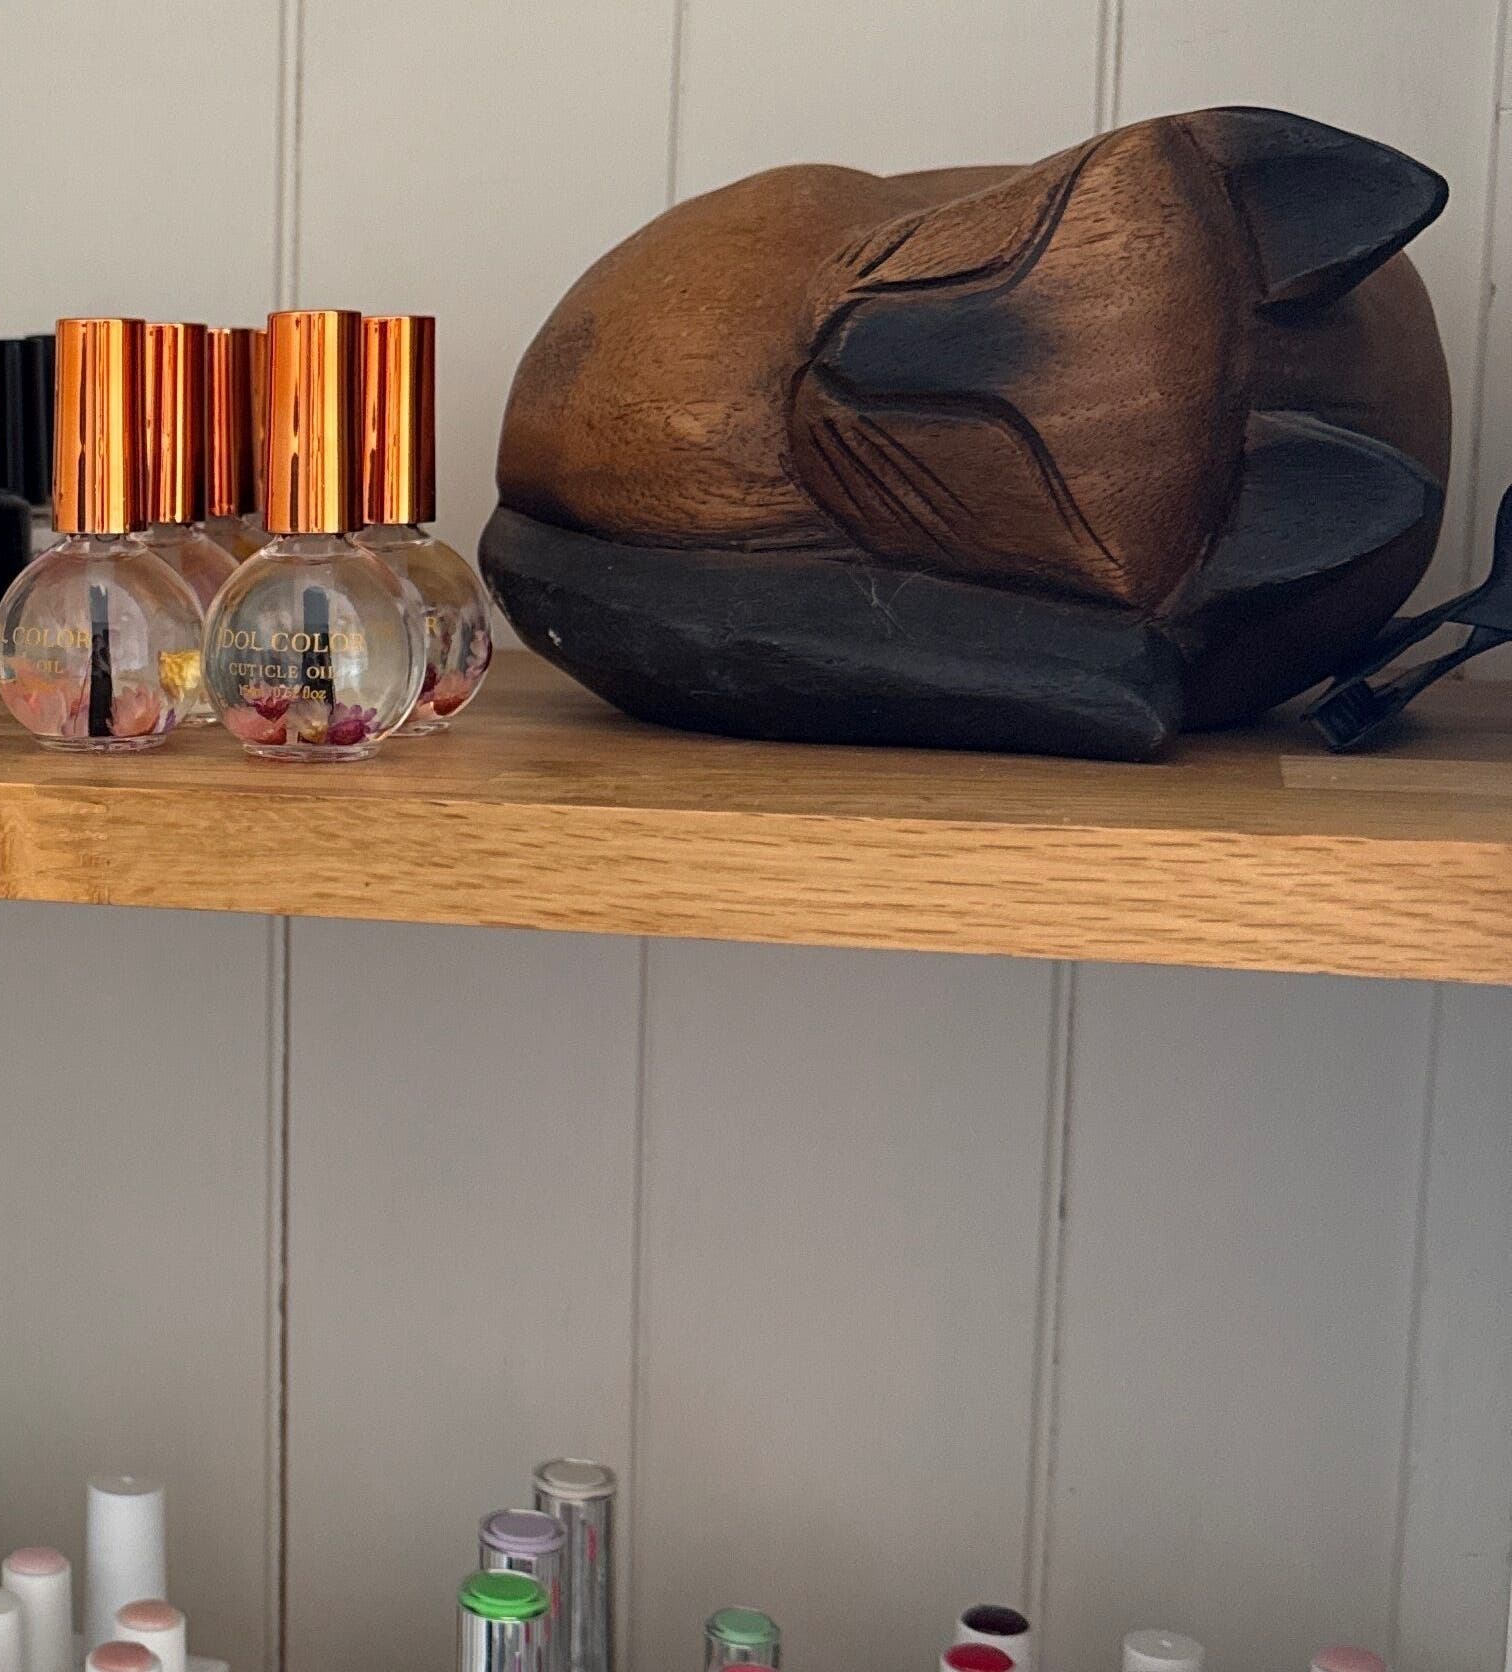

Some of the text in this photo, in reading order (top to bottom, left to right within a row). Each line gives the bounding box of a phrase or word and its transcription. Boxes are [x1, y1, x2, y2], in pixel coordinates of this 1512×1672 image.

[271, 632, 365, 652] COLOR
[228, 662, 338, 681] CUTICLE OIL
